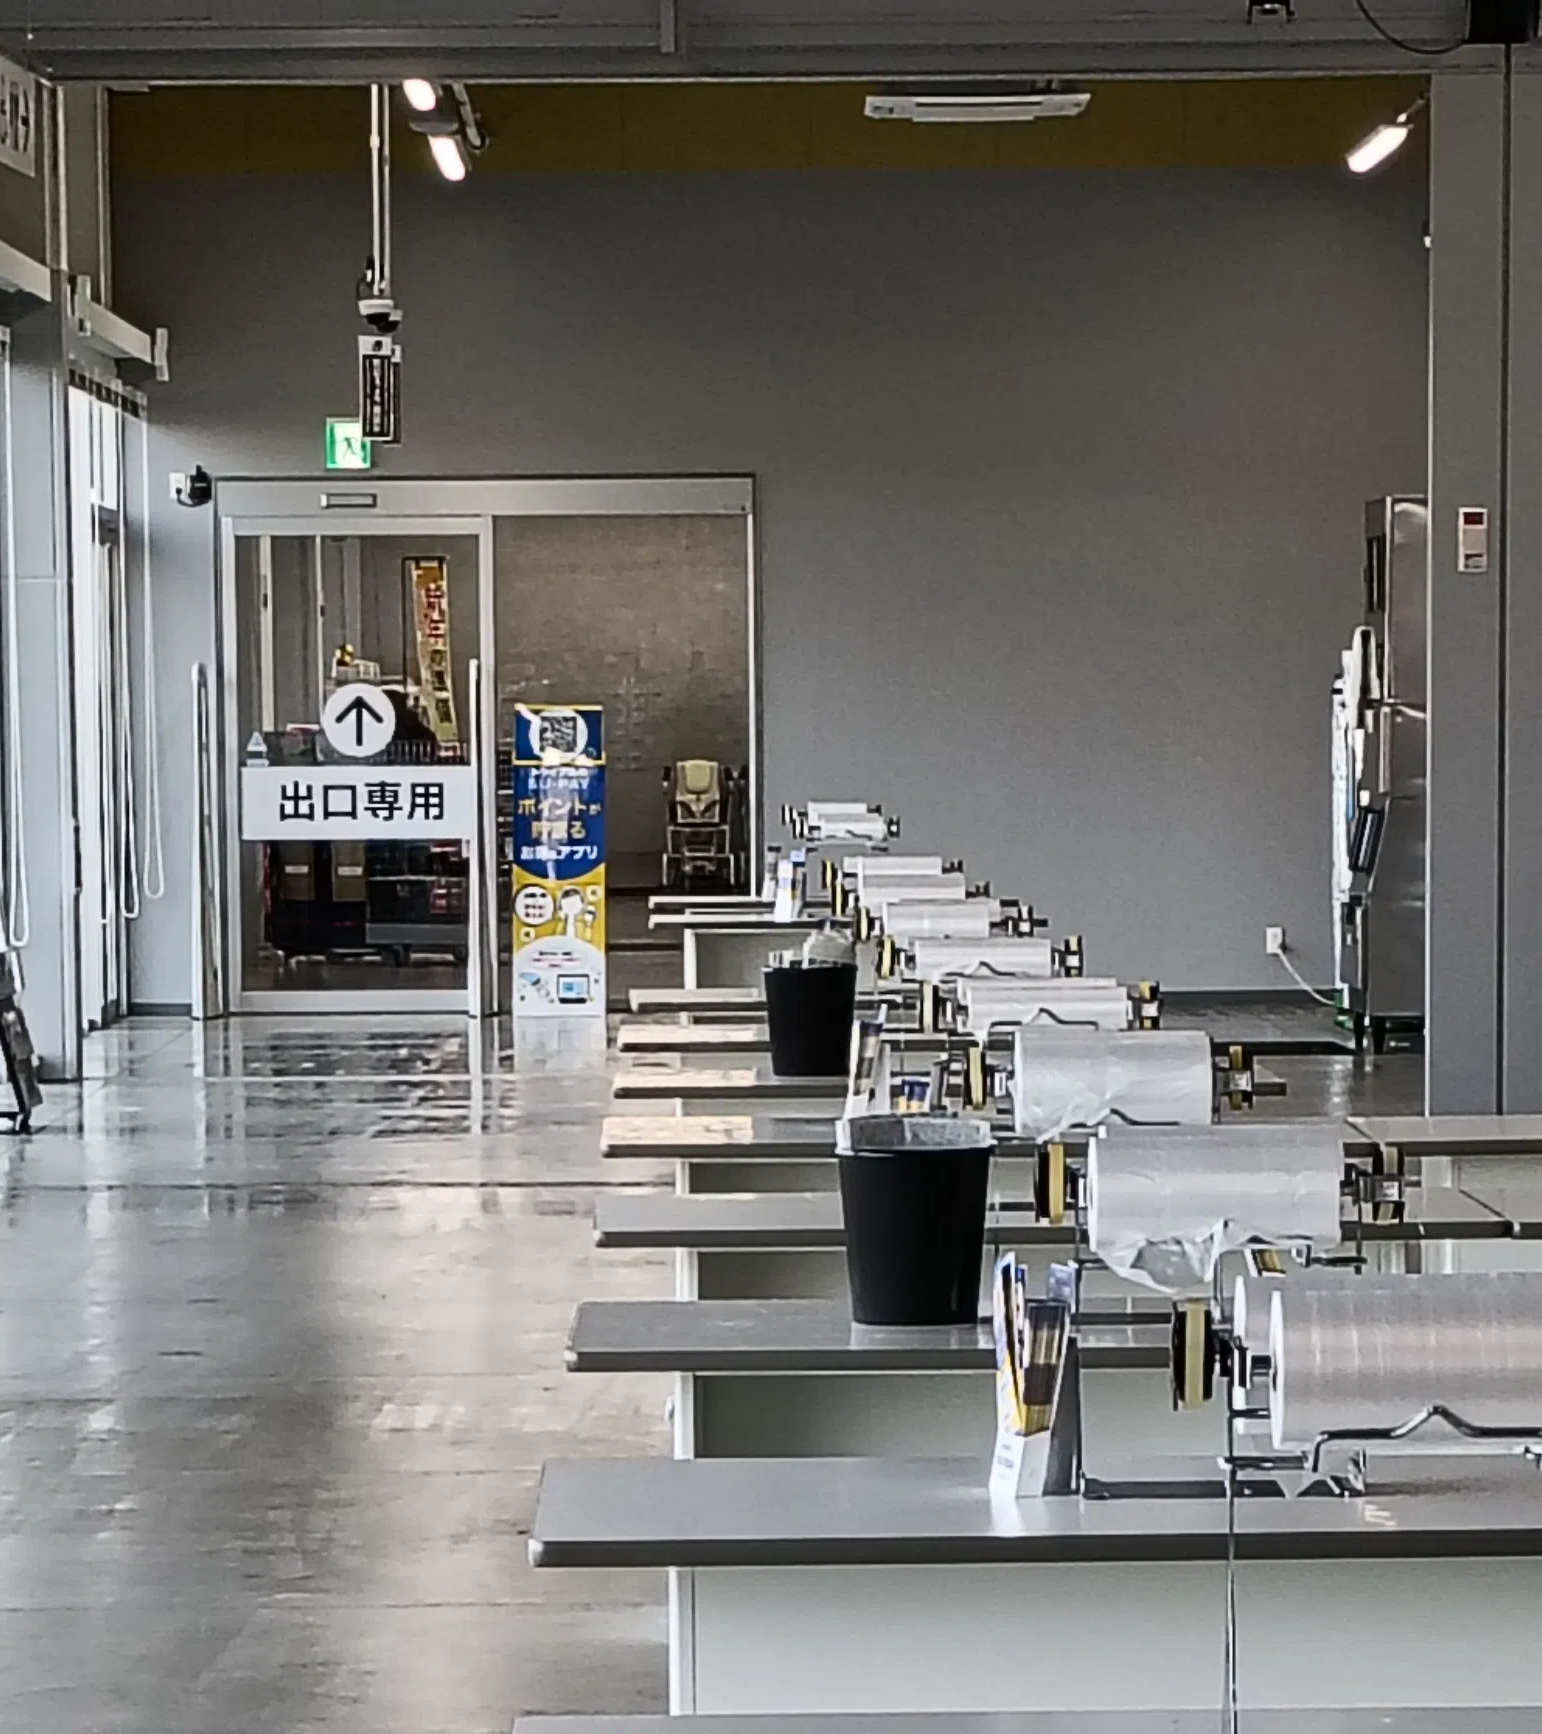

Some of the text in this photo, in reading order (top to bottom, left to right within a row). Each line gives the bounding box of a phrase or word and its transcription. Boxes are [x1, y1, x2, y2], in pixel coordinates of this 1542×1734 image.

[279, 780, 445, 822] 出口専用
[518, 797, 602, 816] ポイントが
